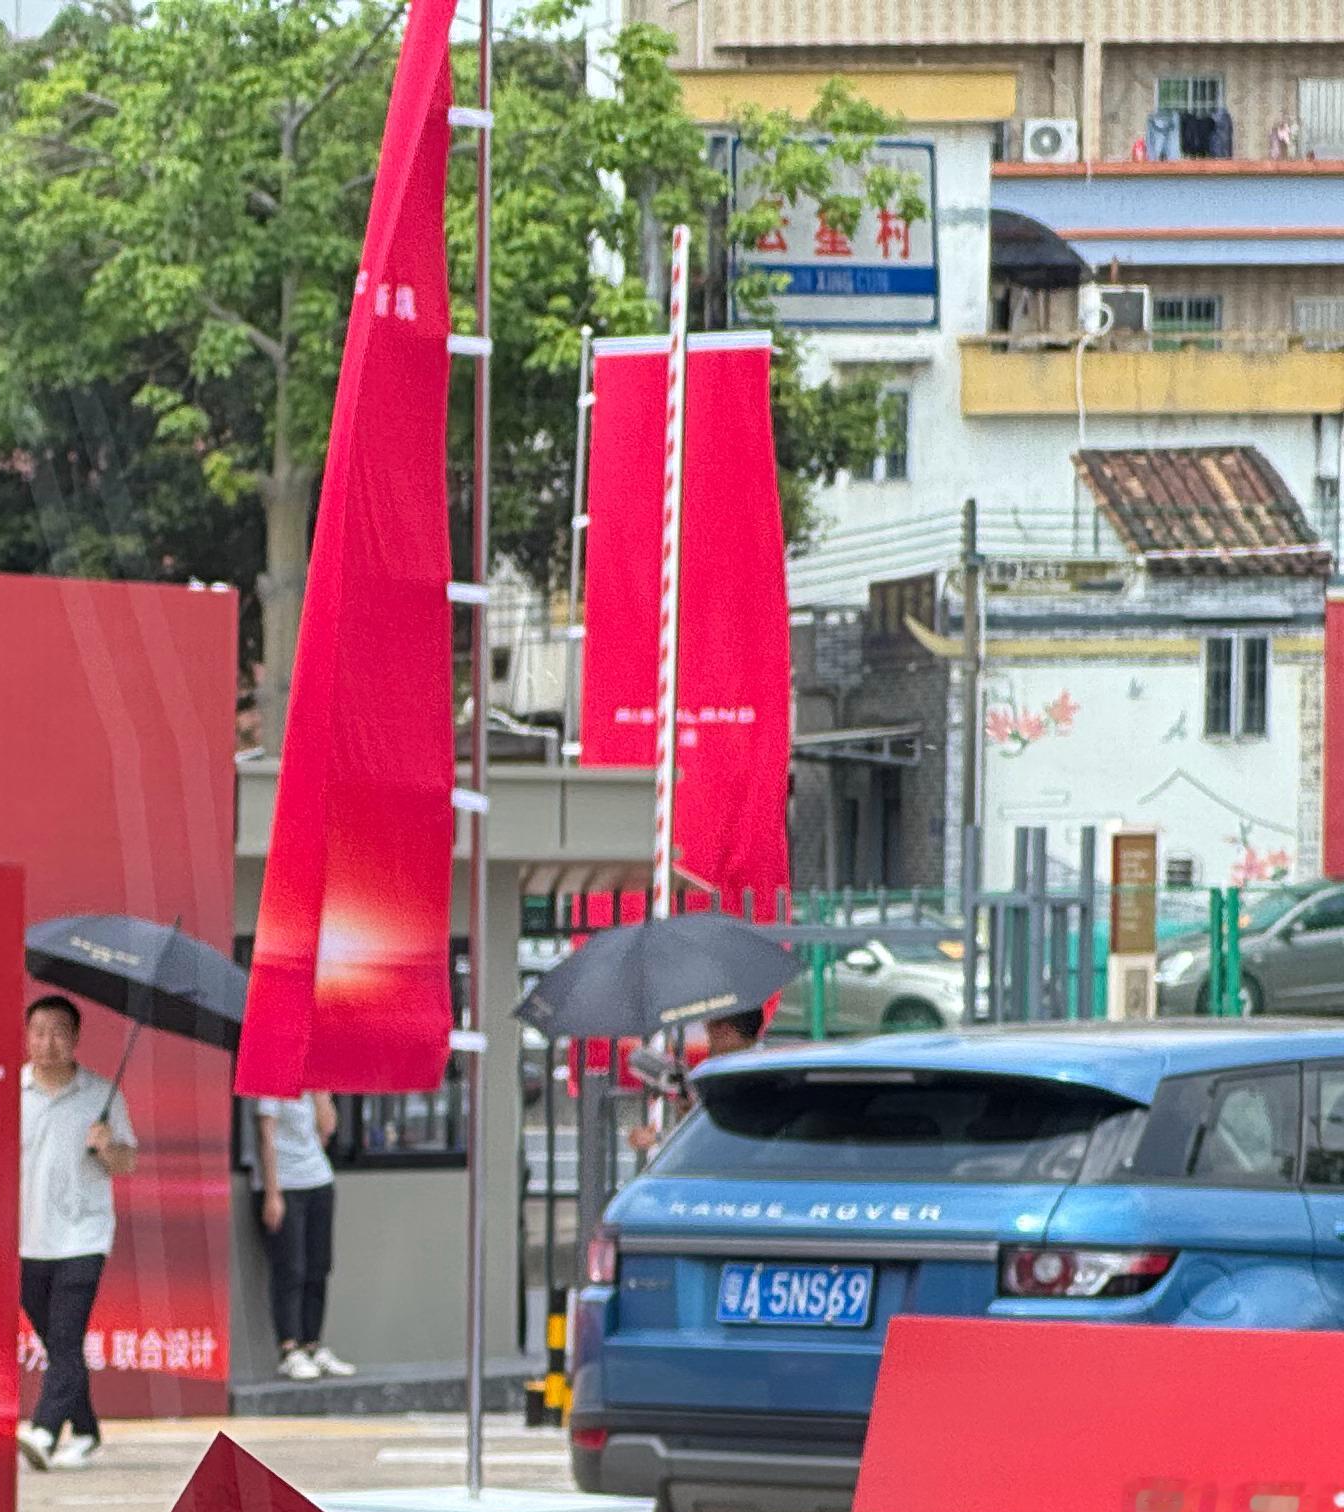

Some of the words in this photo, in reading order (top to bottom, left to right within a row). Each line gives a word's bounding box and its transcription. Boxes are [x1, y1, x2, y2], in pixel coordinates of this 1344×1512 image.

[809, 1201, 942, 1222] ROVER
[111, 1328, 216, 1372] 联合设计
